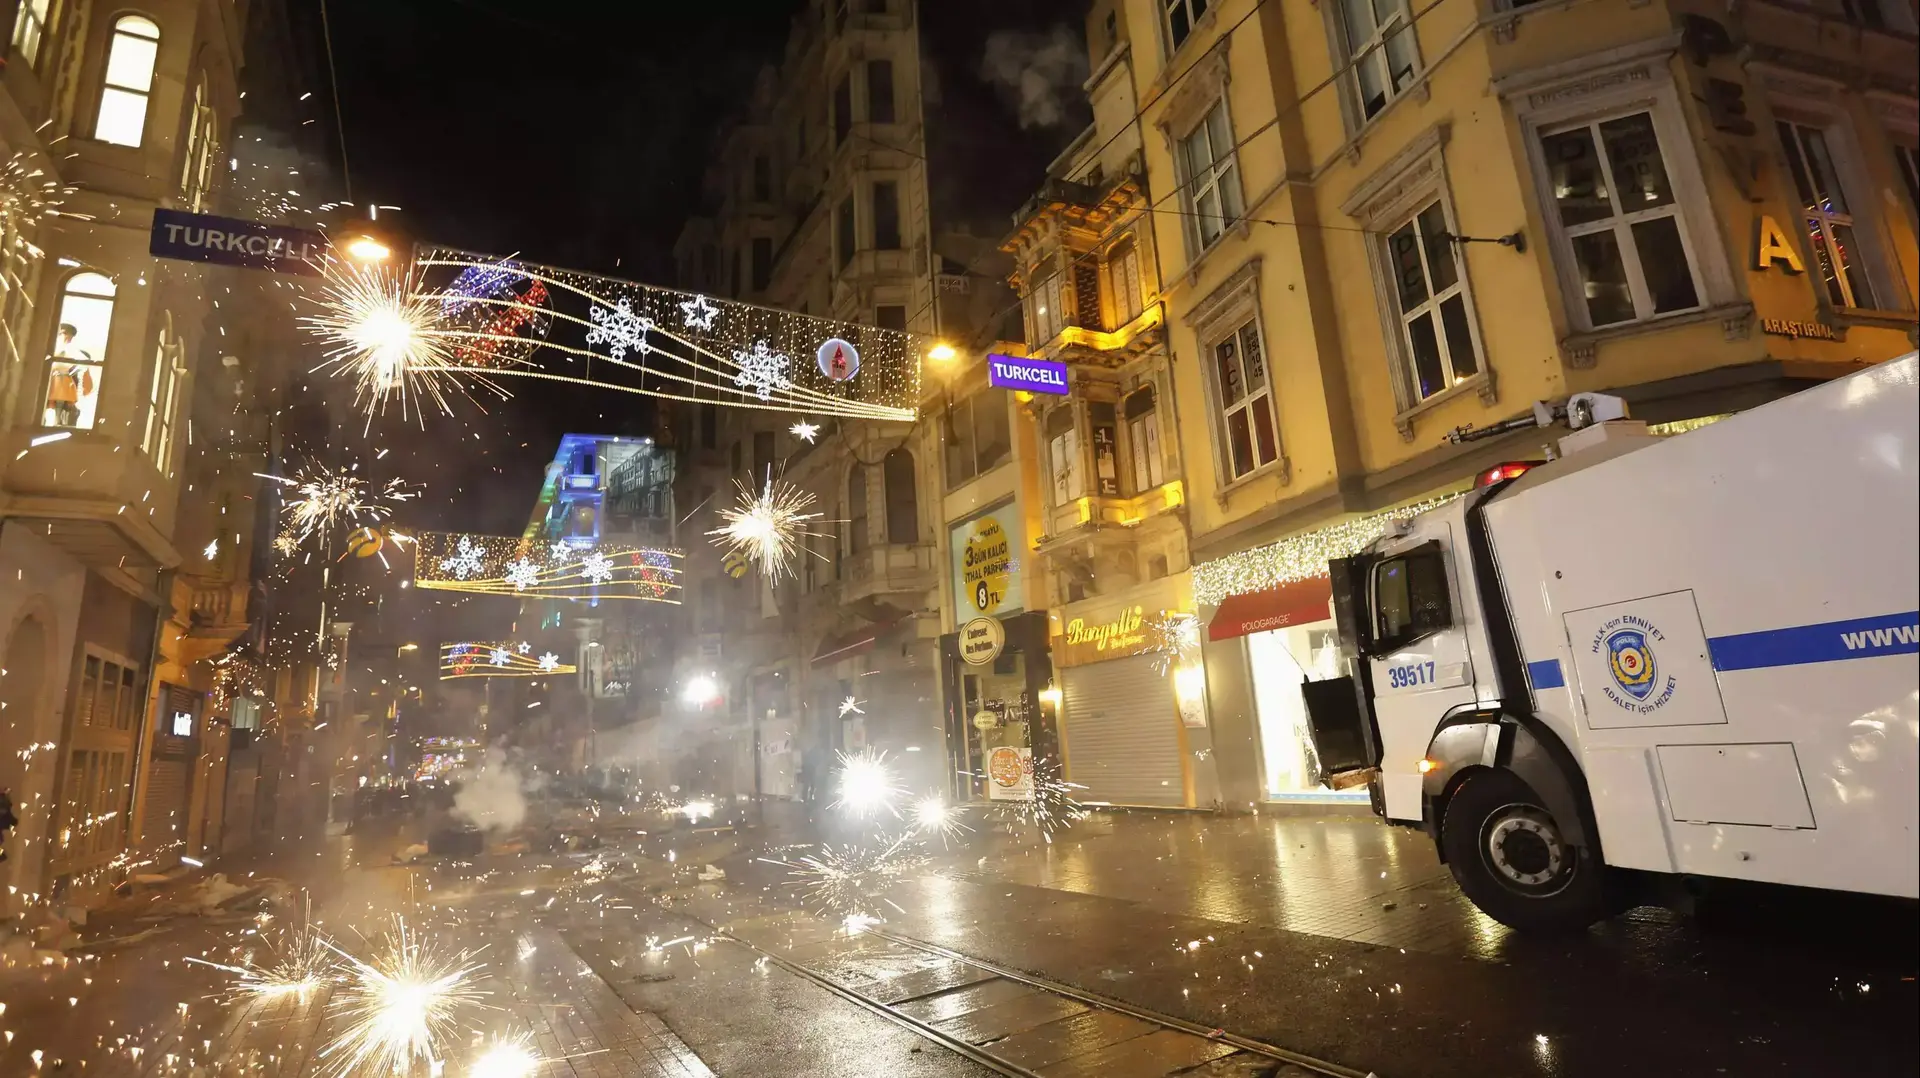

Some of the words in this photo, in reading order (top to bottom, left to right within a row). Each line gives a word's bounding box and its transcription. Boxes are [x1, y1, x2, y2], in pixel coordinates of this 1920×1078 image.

[164, 223, 317, 262] TURKCELL
[993, 362, 1065, 386] TURKCELL
[965, 546, 974, 567] 3
[974, 549, 987, 564] GÜN
[987, 540, 1008, 559] KALICI
[990, 591, 1001, 605] TL
[1241, 614, 1288, 631] POLOGARAGE
[1591, 627, 1606, 653] HALK
[1622, 615, 1665, 642] EMNİYET
[1388, 661, 1435, 688] 39517
[1602, 686, 1636, 712] ADALET
[1654, 675, 1677, 709] HİZMET
